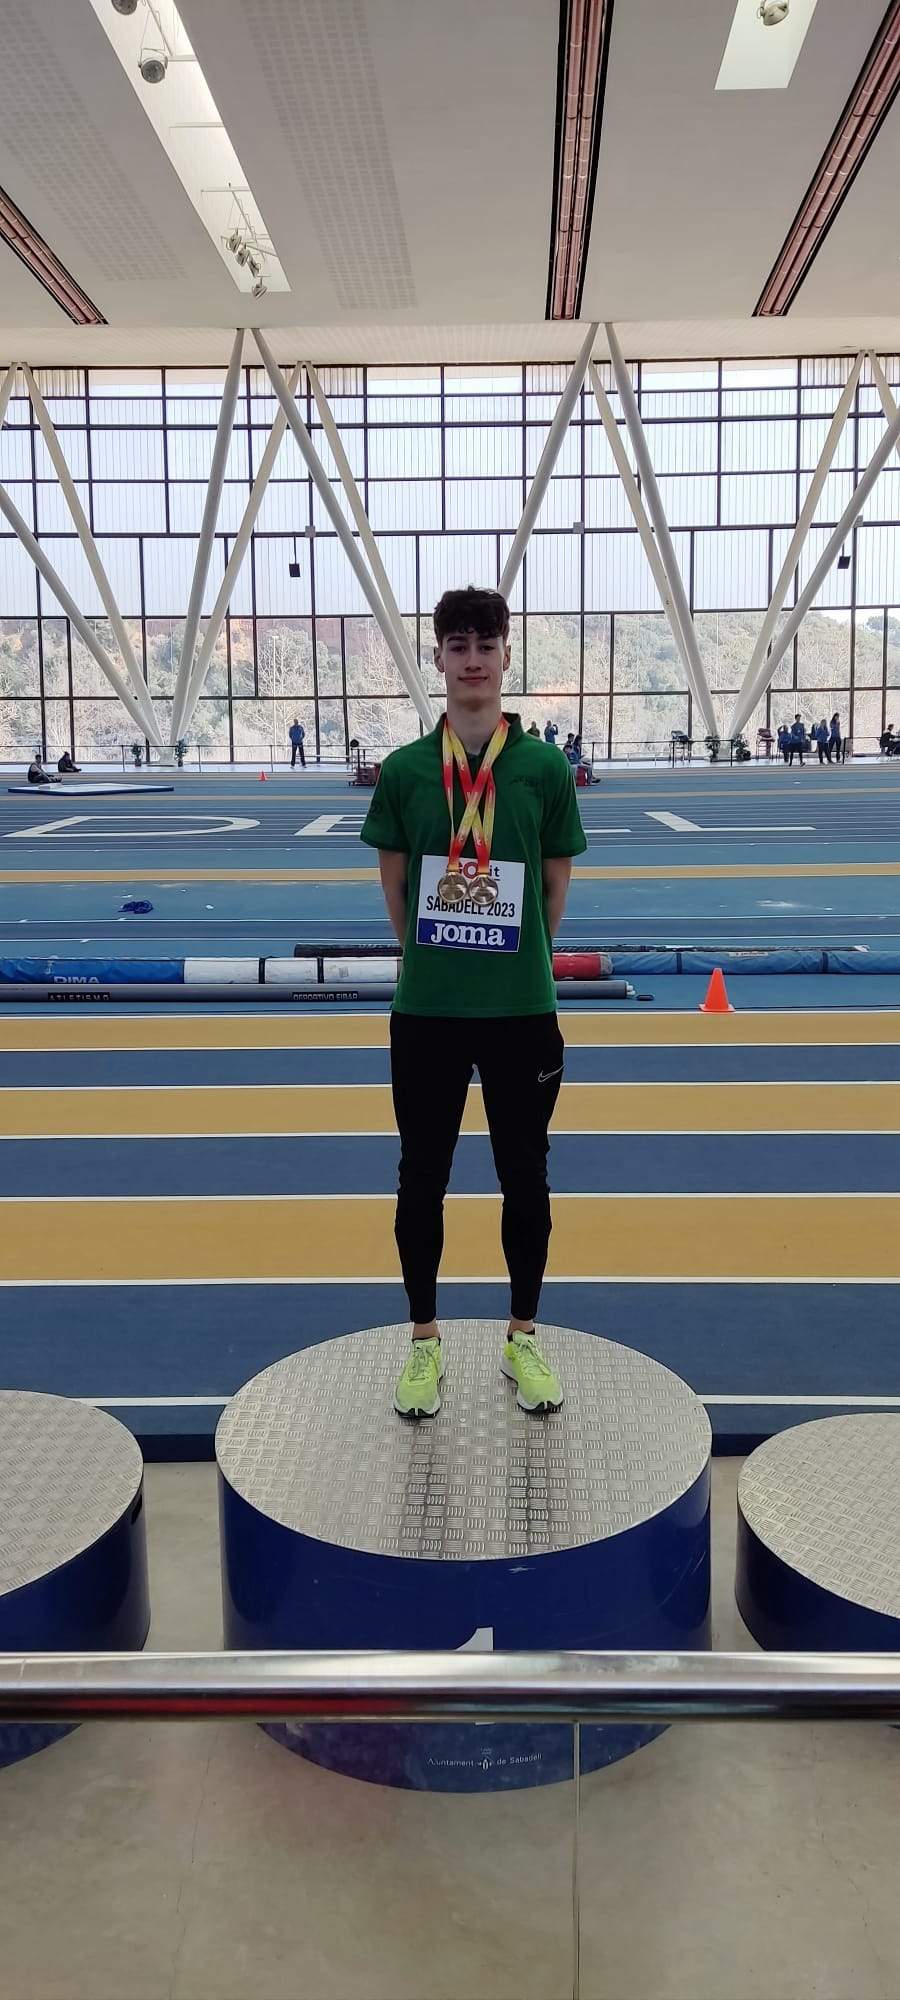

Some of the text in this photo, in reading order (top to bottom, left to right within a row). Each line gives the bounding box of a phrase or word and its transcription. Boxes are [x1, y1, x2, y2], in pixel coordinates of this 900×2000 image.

[426, 896, 516, 918] SABADELL 2023
[53, 976, 100, 984] DIMA
[496, 1758, 507, 1766] de
